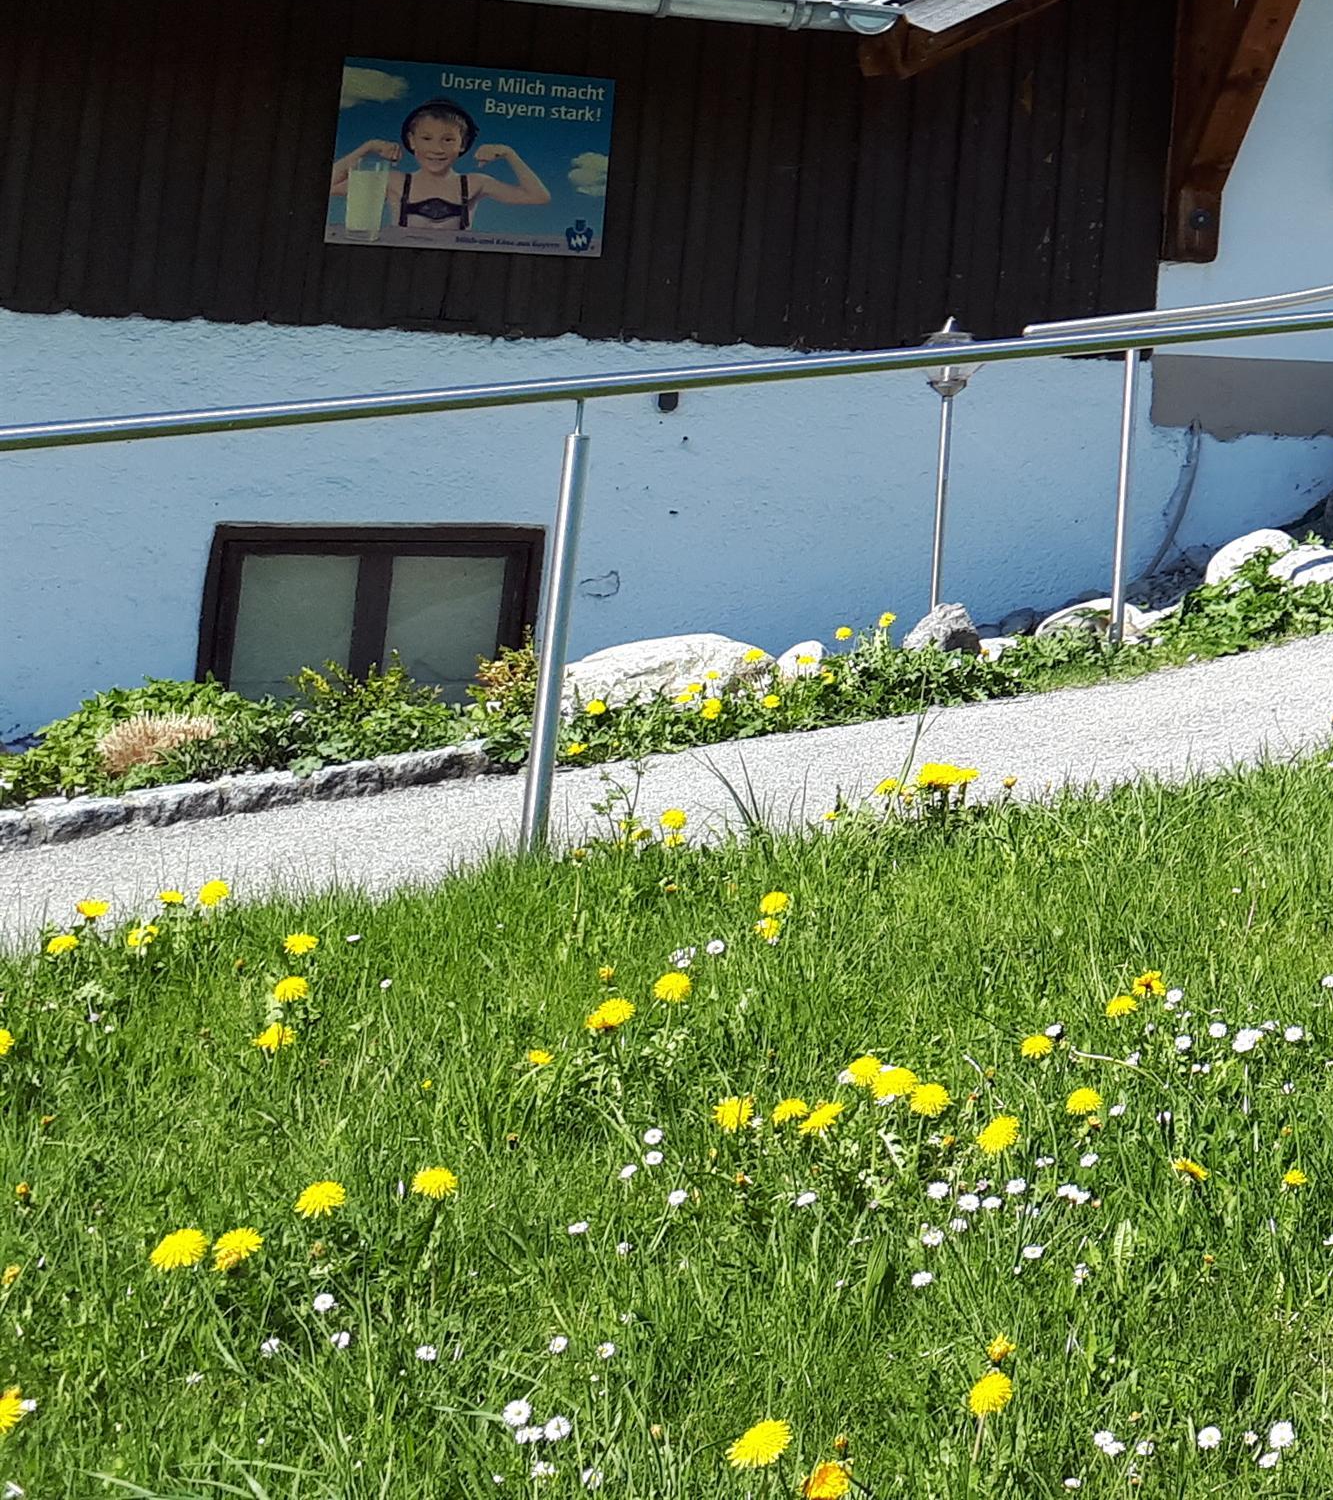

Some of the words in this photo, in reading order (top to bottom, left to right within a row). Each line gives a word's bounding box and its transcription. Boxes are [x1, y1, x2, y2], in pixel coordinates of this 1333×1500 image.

[441, 72, 492, 91] Unsre
[498, 77, 546, 97] Milch
[551, 84, 606, 102] macht
[484, 98, 545, 120] Bayern
[550, 106, 603, 123] stark!
